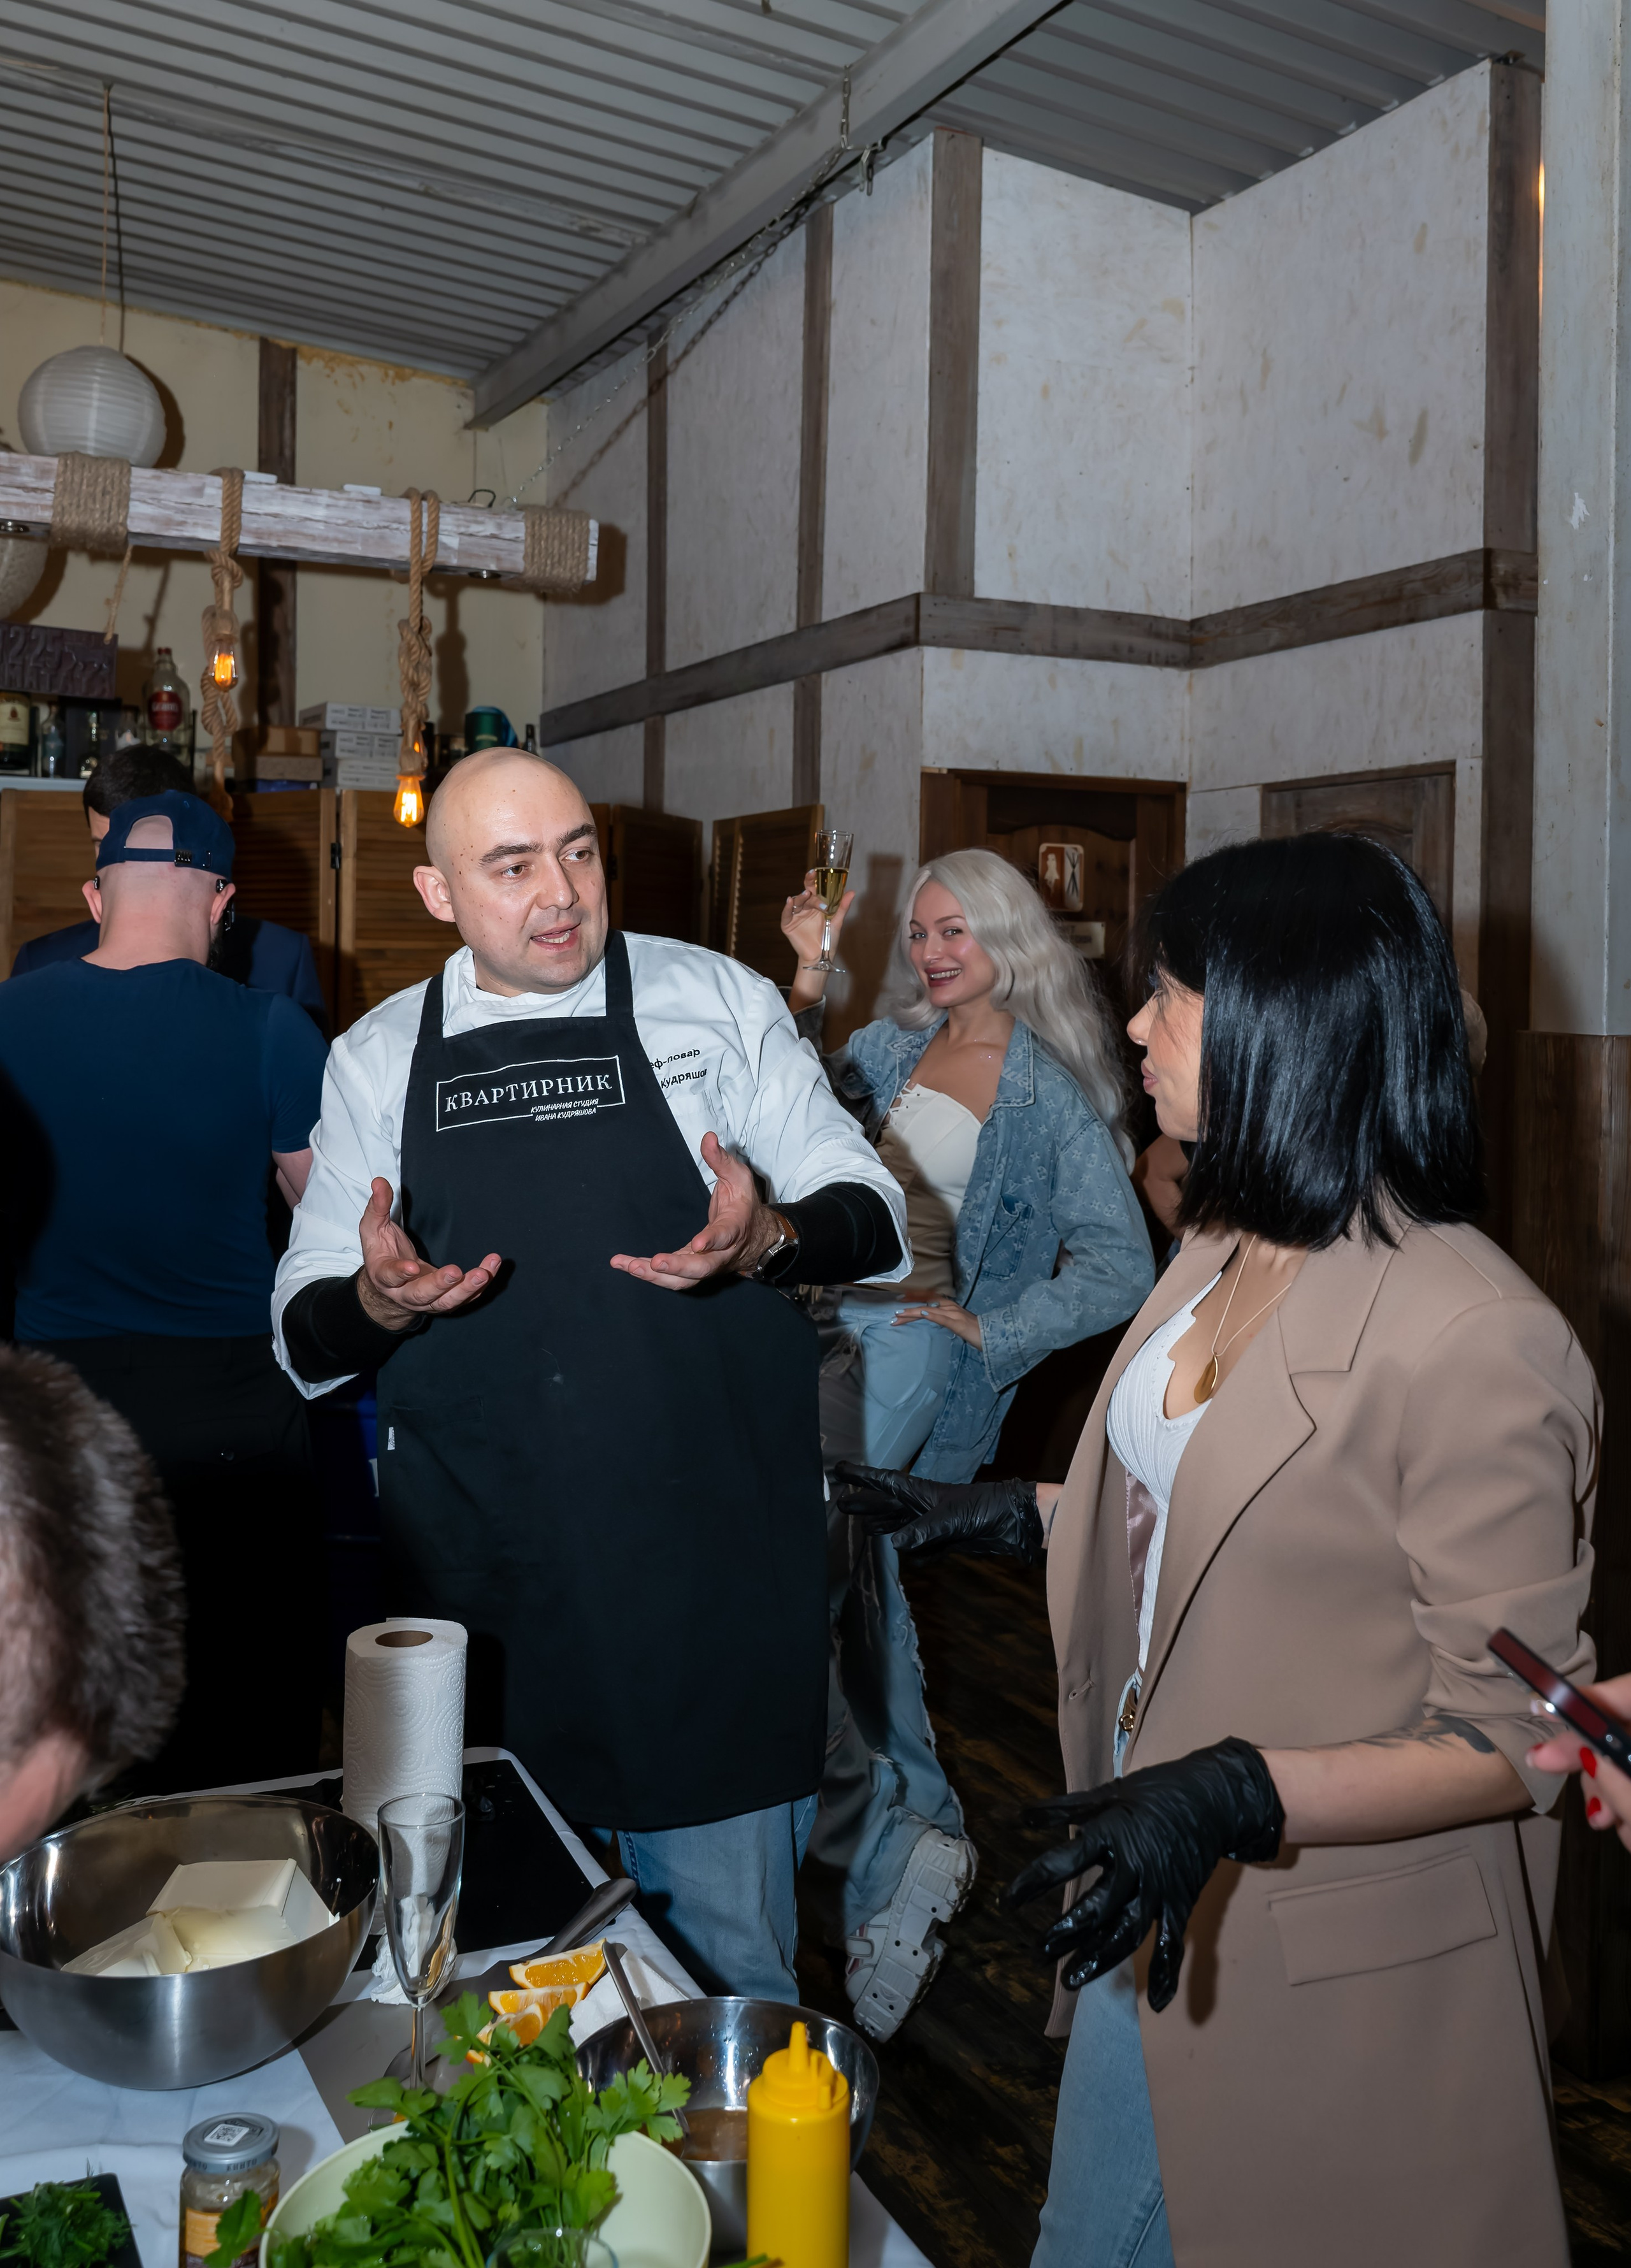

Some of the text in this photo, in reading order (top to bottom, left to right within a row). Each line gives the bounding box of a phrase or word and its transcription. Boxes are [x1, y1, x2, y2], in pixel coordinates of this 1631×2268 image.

[650, 1049, 700, 1069] еф-повар
[445, 1074, 613, 1112] КВАРТИРНИК
[531, 1098, 599, 1113] КУЛИНАРНАЯ СТУДИЯ
[535, 1108, 596, 1122] ИВАНА КУДРЯШОВА
